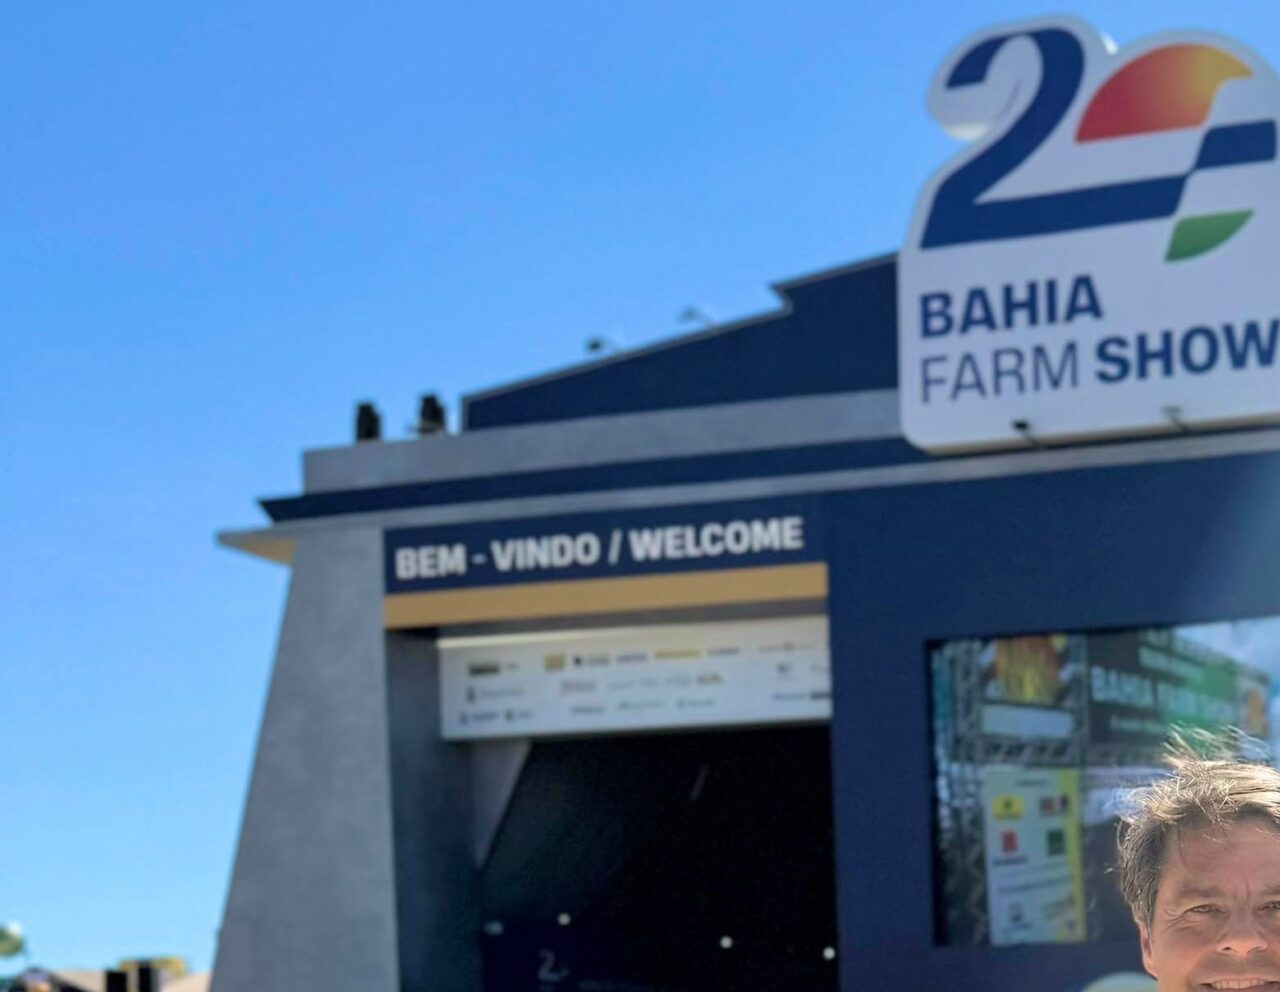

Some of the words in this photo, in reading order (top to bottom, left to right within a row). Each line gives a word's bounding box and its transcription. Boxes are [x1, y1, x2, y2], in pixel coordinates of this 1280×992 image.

[920, 274, 1103, 339] BAHIA
[921, 341, 1078, 402] FARM
[395, 543, 467, 580] BEM
[491, 533, 600, 571] VINDO
[629, 516, 804, 561] WELCOME
